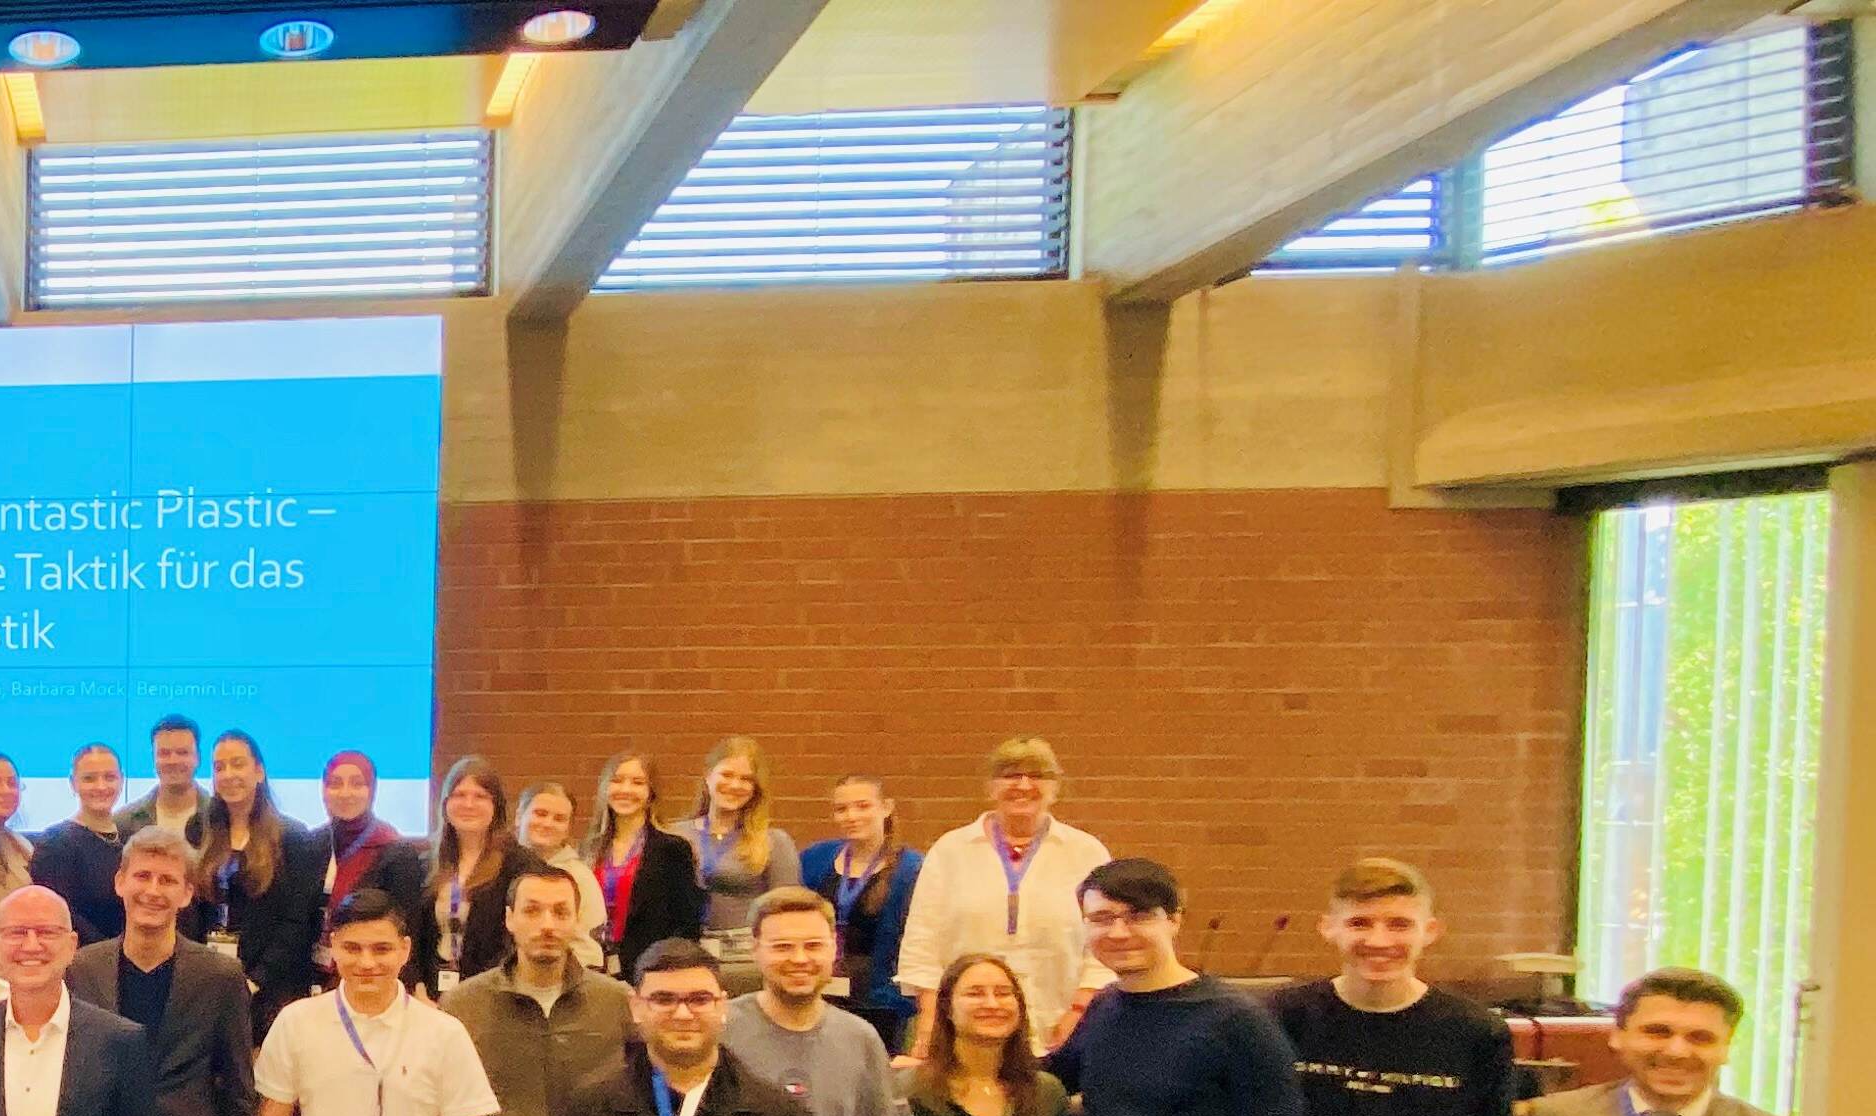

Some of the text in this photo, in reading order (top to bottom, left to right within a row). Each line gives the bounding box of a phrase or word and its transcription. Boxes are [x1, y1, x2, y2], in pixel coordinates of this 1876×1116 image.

[157, 486, 297, 529] Plastic
[15, 550, 146, 591] Taktik
[157, 547, 219, 590] für
[229, 547, 305, 589] das
[11, 680, 76, 697] Barbara
[137, 680, 216, 700] Benjamin
[222, 680, 258, 701] Lipp
